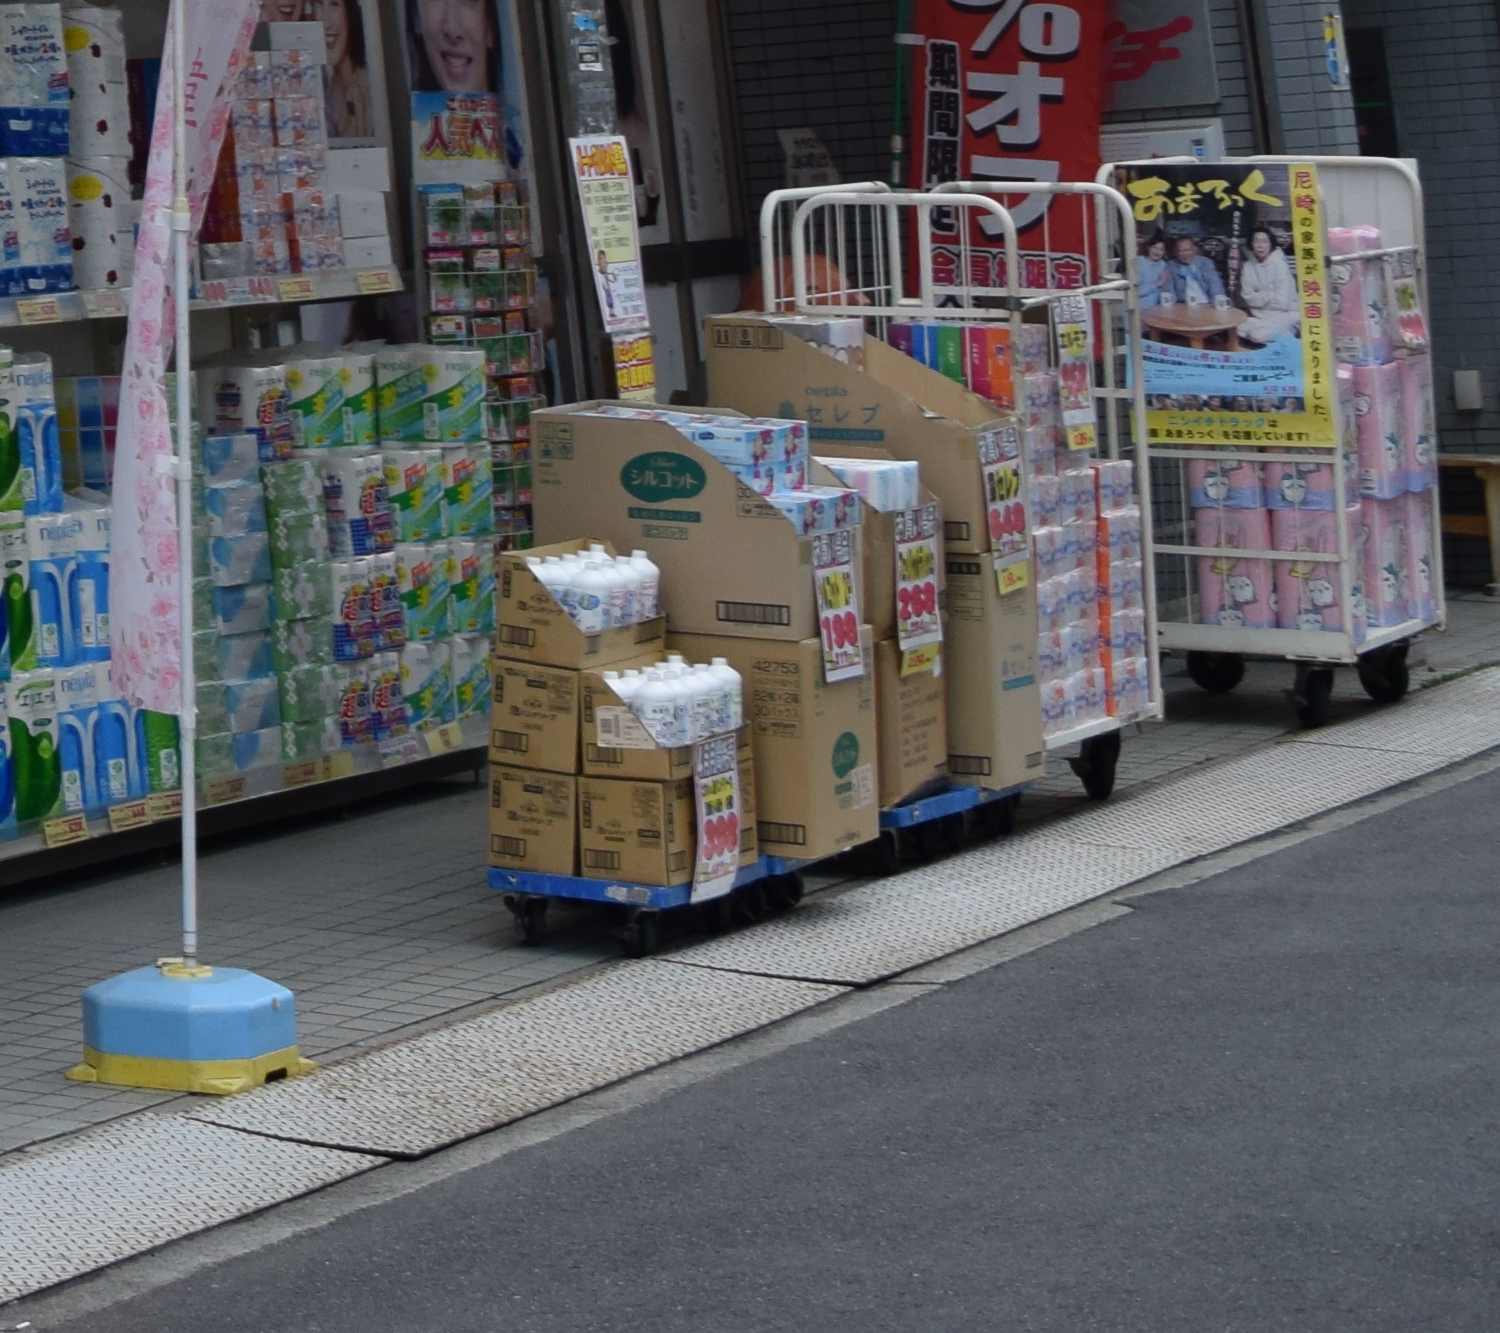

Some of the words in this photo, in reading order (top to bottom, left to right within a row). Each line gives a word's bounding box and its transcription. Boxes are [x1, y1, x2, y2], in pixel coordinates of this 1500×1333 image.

[804, 384, 848, 398] nepia
[630, 468, 698, 487] シルコット
[752, 659, 798, 674] 42753
